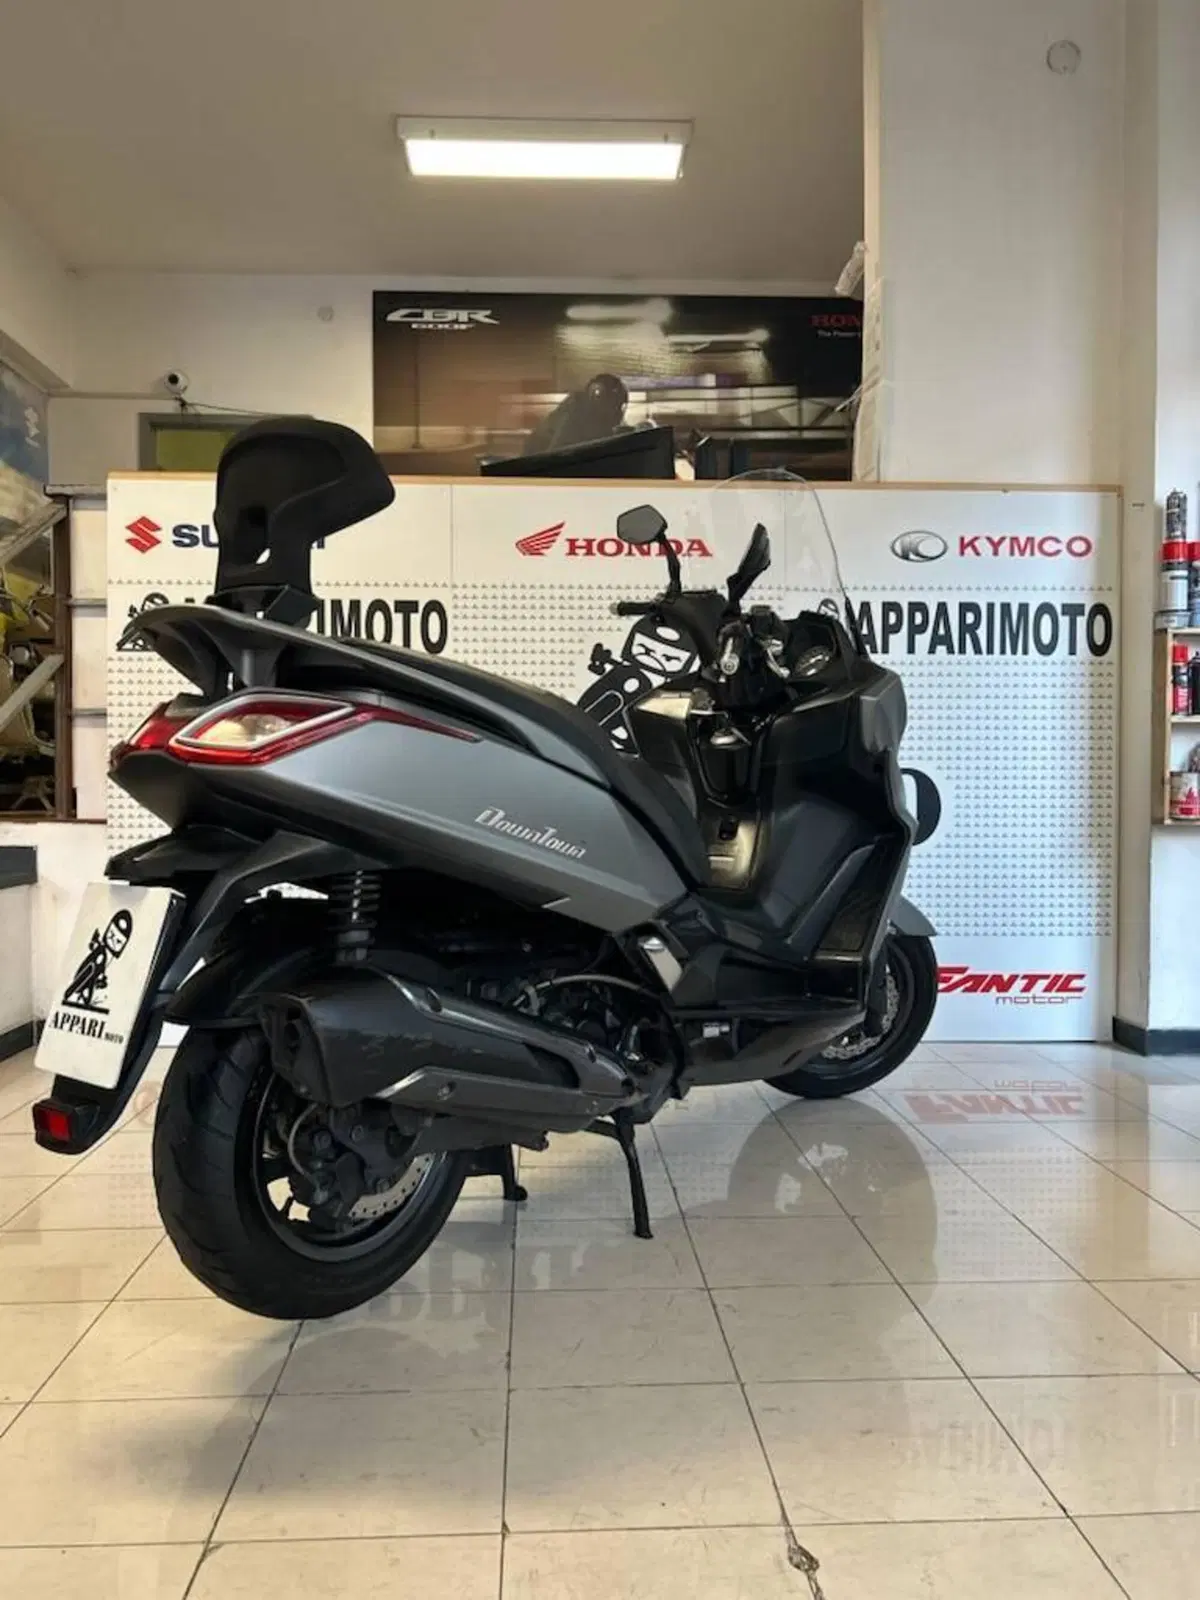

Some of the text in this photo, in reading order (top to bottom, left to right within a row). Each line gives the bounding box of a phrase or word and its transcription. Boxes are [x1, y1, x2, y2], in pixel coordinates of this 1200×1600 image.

[386, 308, 500, 325] CBR
[566, 537, 713, 557] HONDA
[958, 535, 1093, 557] KYMCO
[856, 601, 1113, 657] APPARIMOTO
[995, 995, 1083, 1005] motor
[48, 1010, 106, 1039] APPARI
